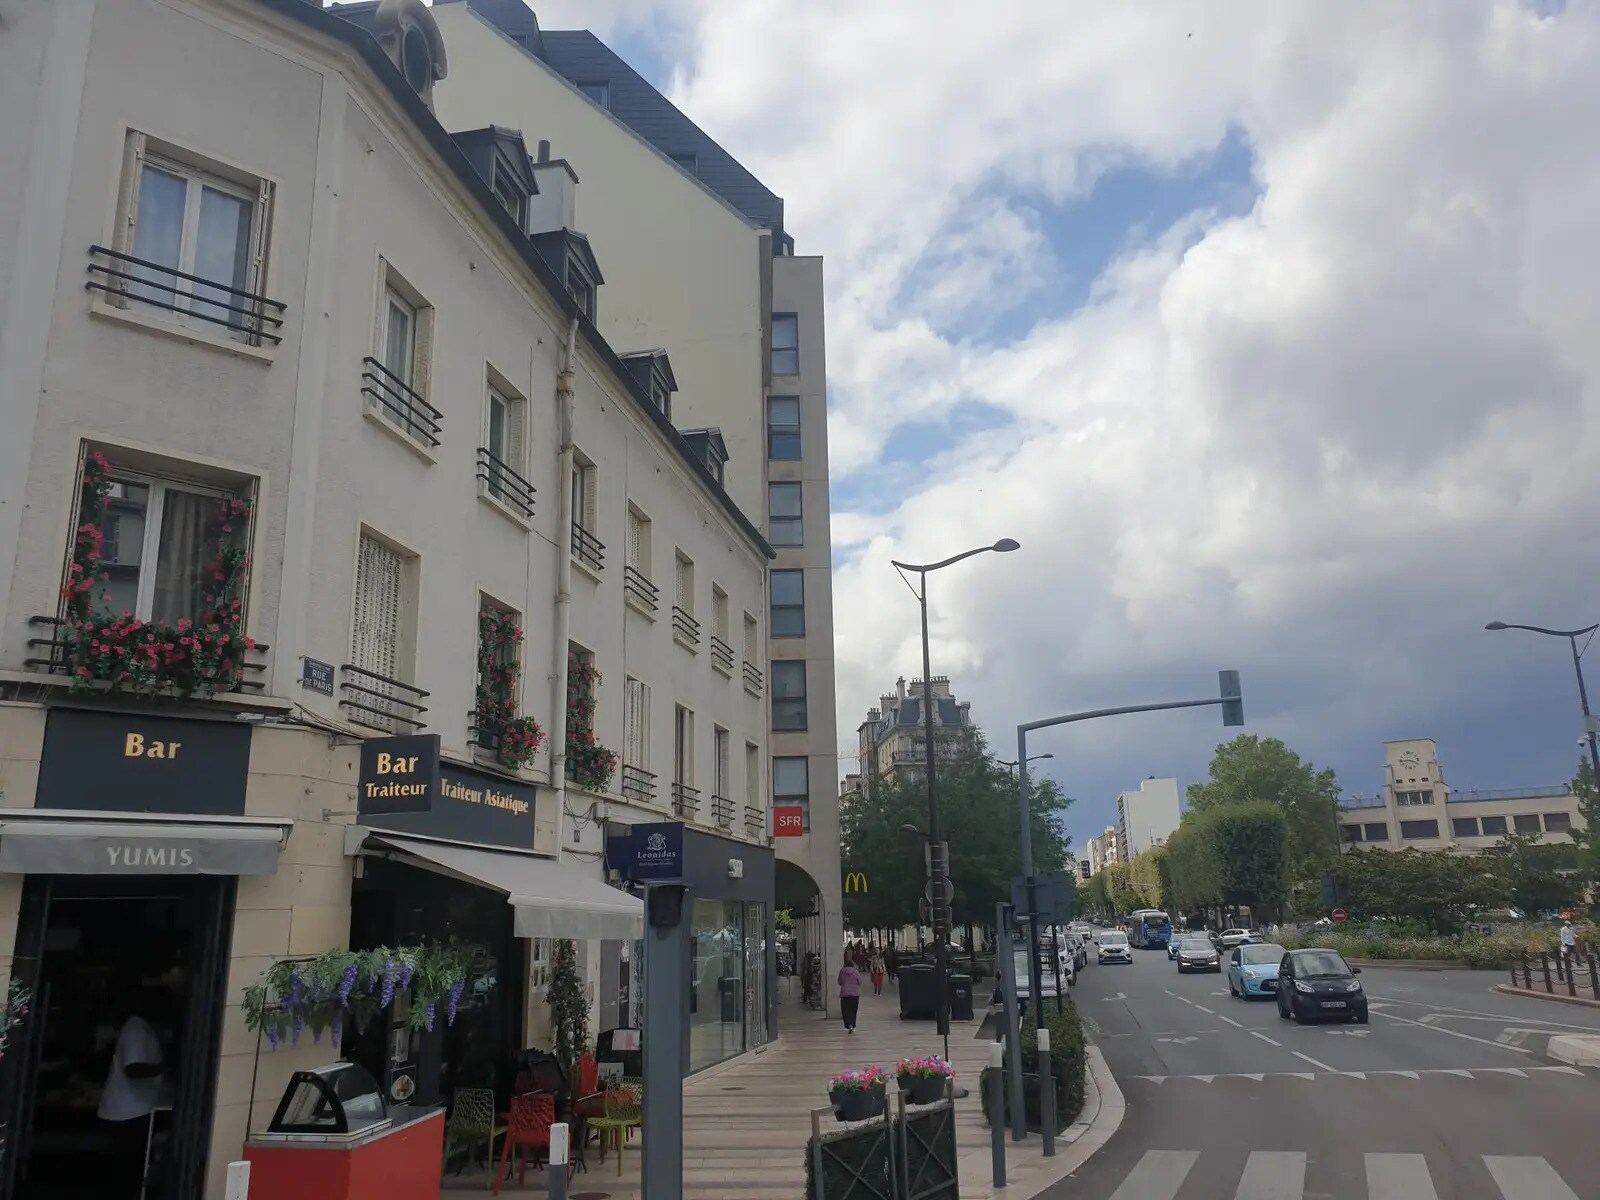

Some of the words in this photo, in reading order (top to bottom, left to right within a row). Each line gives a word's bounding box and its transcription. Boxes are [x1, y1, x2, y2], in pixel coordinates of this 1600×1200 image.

[312, 669, 327, 681] RUE
[313, 679, 332, 692] PARIS
[124, 732, 182, 759] Bar
[376, 752, 419, 775] Bar
[365, 781, 428, 798] Traiteur
[439, 778, 483, 804] Traiteur
[484, 789, 530, 816] Asiatique
[779, 815, 801, 827] SFR
[106, 846, 194, 867] YUMIS
[637, 850, 676, 859] Leonidas
